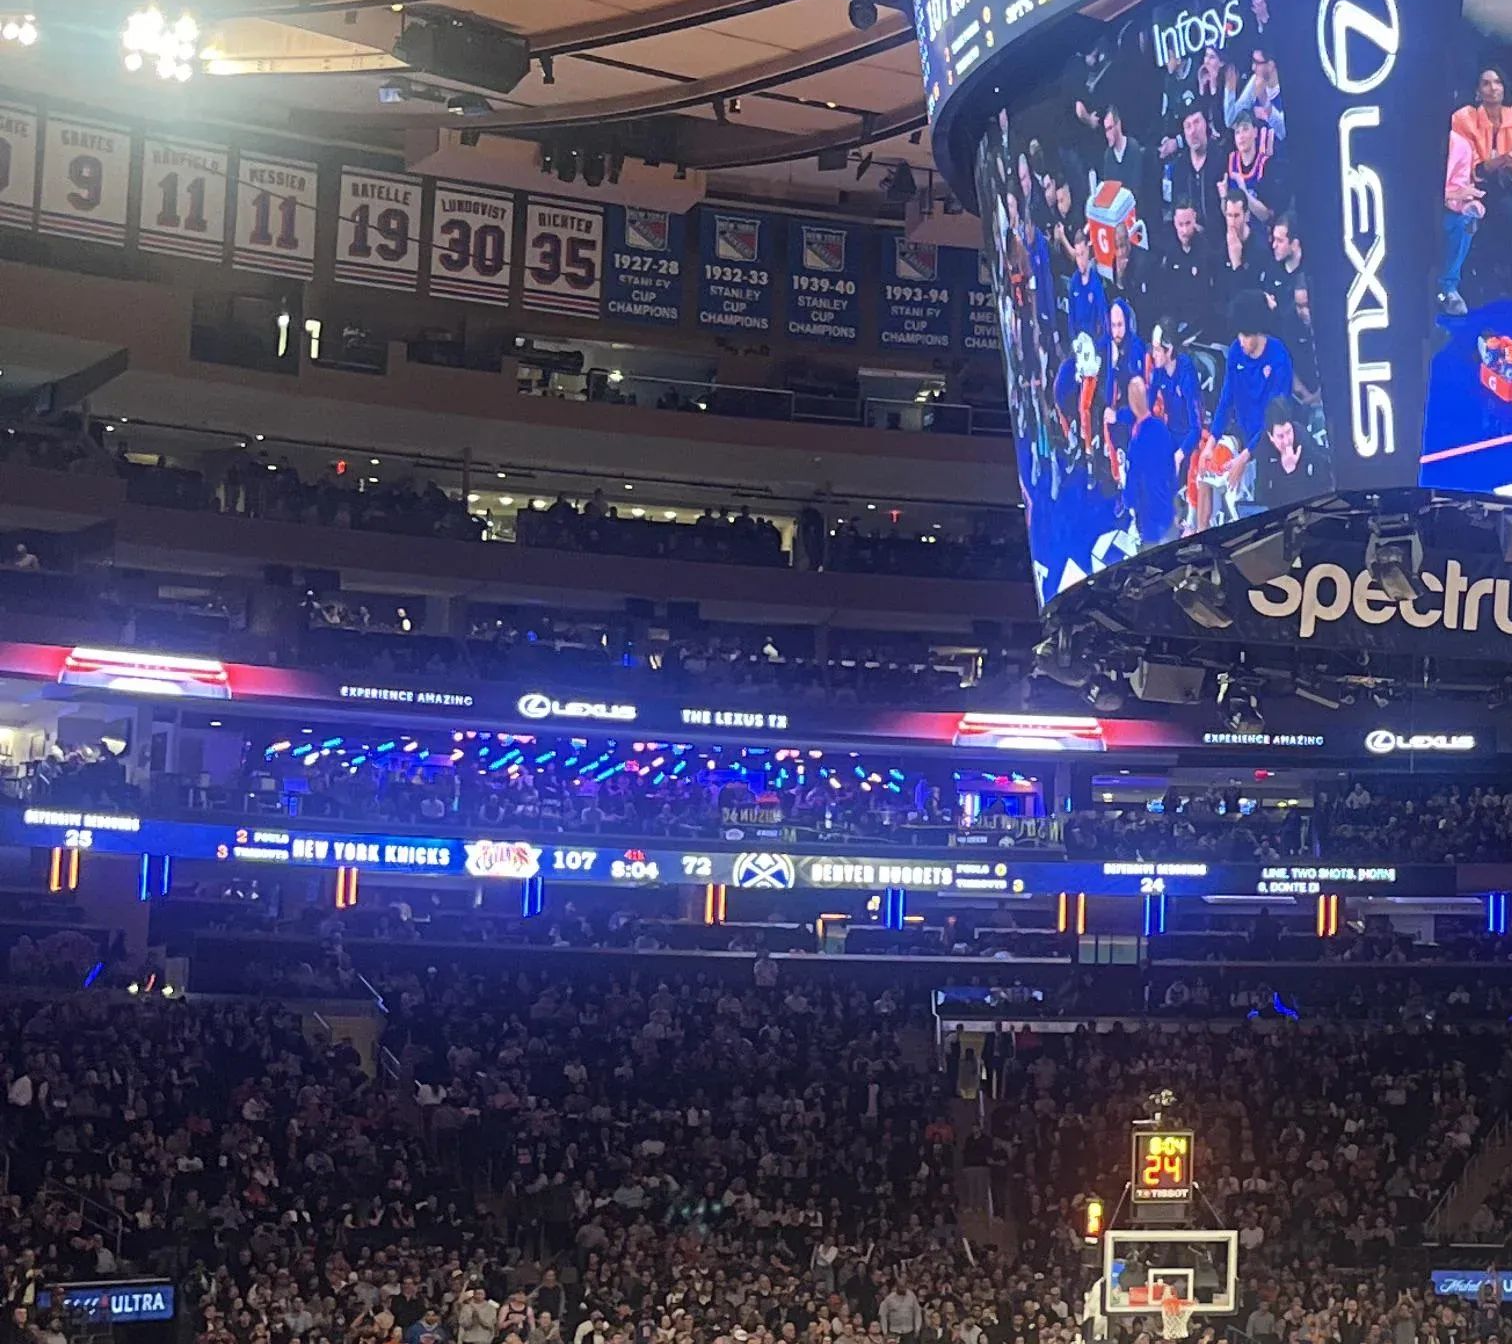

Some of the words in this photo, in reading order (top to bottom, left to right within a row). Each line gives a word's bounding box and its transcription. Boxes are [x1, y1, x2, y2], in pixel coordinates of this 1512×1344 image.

[67, 154, 103, 212] 9
[157, 171, 208, 232] 11
[351, 181, 412, 206] RATELLE
[441, 198, 508, 221] LUNDQVIST
[250, 190, 299, 250] 11
[538, 212, 593, 234] RICHTER
[349, 204, 409, 261] 19
[440, 219, 505, 277] 30
[531, 232, 597, 290] 35
[614, 253, 680, 275] 1927-28
[704, 264, 769, 285] 1932-33
[792, 274, 855, 295] 1939-40
[1338, 105, 1394, 458] LEXUS
[631, 290, 656, 302] CUP
[885, 285, 949, 303] 1993-94
[608, 301, 678, 320] CHAMPIONS
[723, 301, 747, 313] CUP
[811, 311, 834, 323] CUP
[700, 311, 769, 330] CHAMPIONS
[788, 321, 856, 339] CHAMPIONS
[904, 319, 927, 331] CUP
[881, 331, 949, 347] CHAMPIONS
[340, 686, 413, 703] EXPERIENCE
[417, 692, 473, 706] AMAZING
[552, 701, 638, 720] LEXUS
[681, 709, 712, 725] THE
[715, 711, 764, 727] LEXUS
[1204, 733, 1270, 745] EXPERIENCE
[1272, 735, 1324, 746] AMAZING
[1397, 735, 1475, 749] LEXUS
[64, 829, 93, 847] 25
[292, 839, 328, 859] NEW
[334, 841, 379, 862] YORK
[385, 844, 450, 865] KNICKS
[553, 850, 597, 869] 107
[610, 860, 659, 879] 8:04
[681, 856, 712, 876] 72
[811, 863, 874, 883] DENVER
[878, 866, 953, 886] NUGGETS
[1140, 877, 1165, 892] 24
[1143, 1155, 1181, 1185] 24
[111, 1292, 165, 1314] ULTRA
